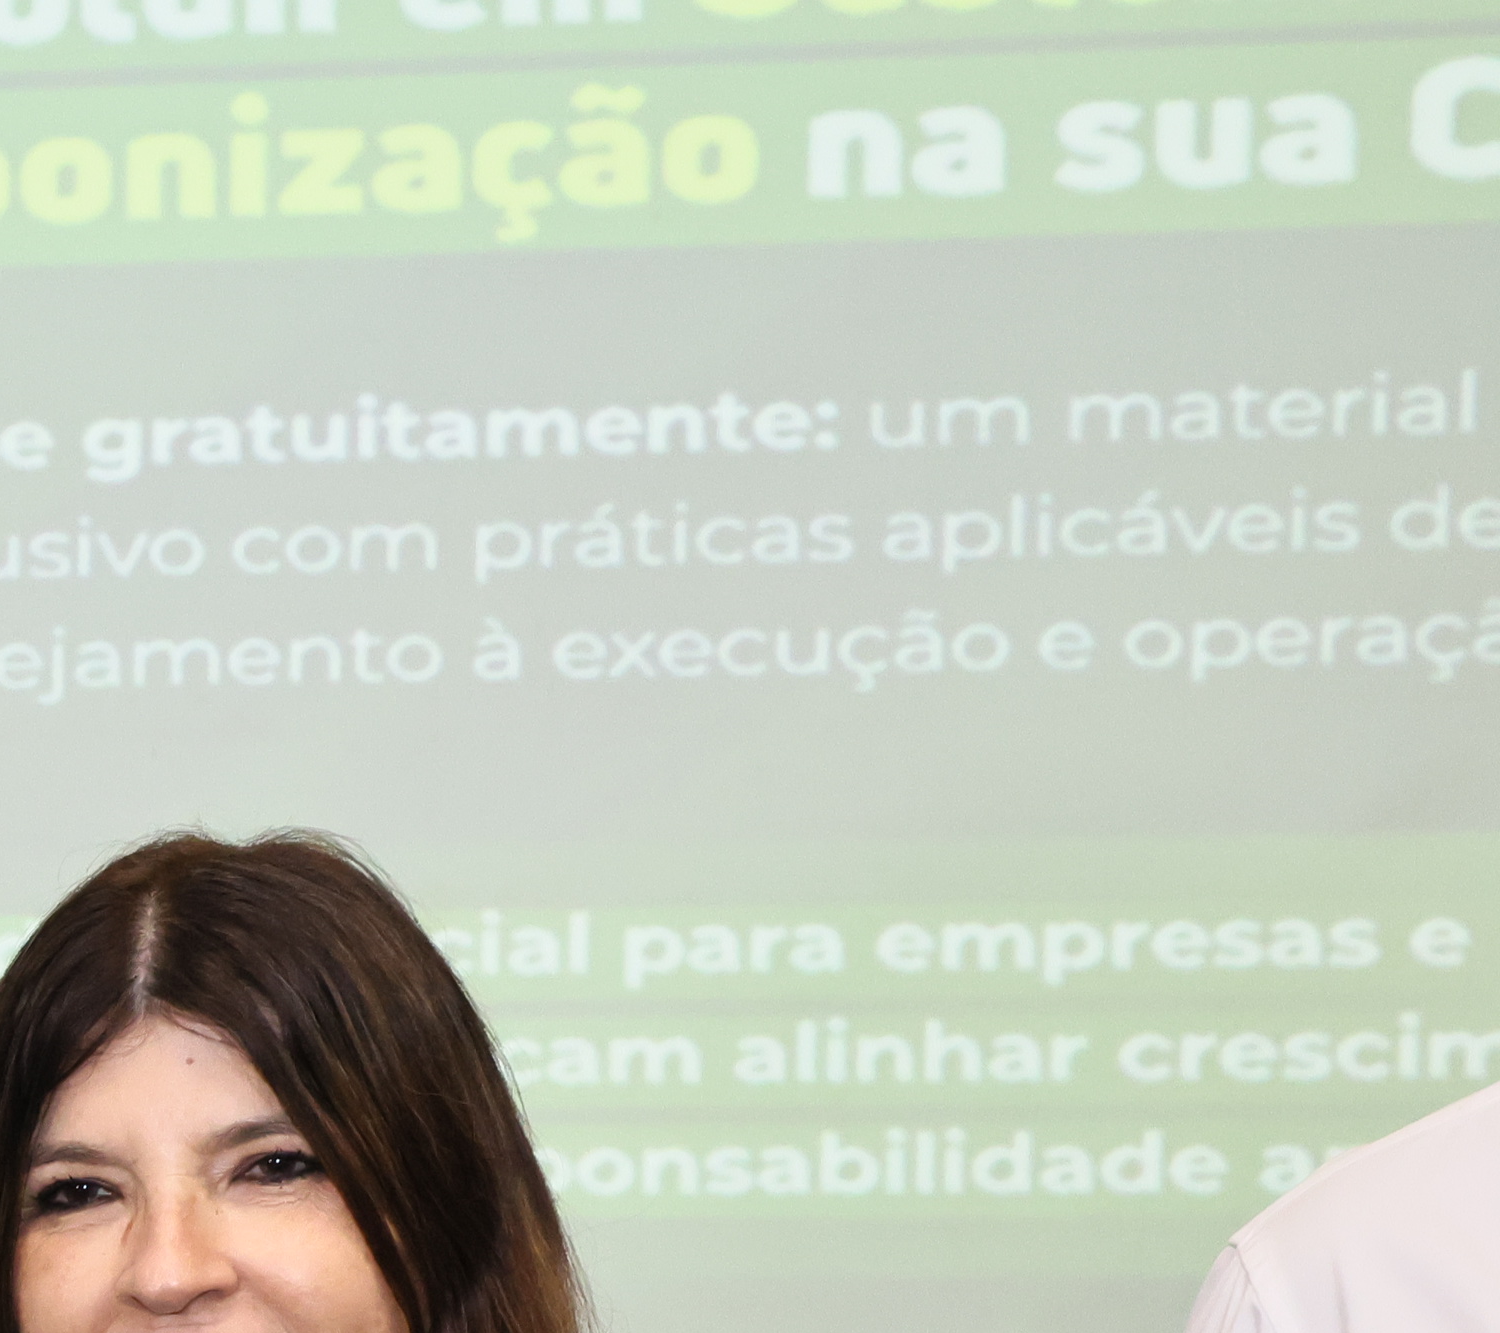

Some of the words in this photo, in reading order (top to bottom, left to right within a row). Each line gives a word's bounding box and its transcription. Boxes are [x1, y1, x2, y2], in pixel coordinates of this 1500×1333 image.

[805, 103, 1006, 200] na
[1053, 90, 1358, 191] sua
[82, 392, 840, 483] gratuitamente:
[869, 395, 1032, 449] um
[1068, 367, 1481, 443] material
[231, 519, 439, 578] com
[474, 502, 854, 584] práticas
[881, 484, 1363, 574] aplicáveis
[473, 617, 524, 682] à
[551, 608, 1011, 694] execução
[1037, 619, 1095, 671] e
[623, 918, 846, 989] para
[874, 913, 1380, 987] empresas
[1408, 914, 1472, 969] e
[732, 1015, 1090, 1087] alinhar
